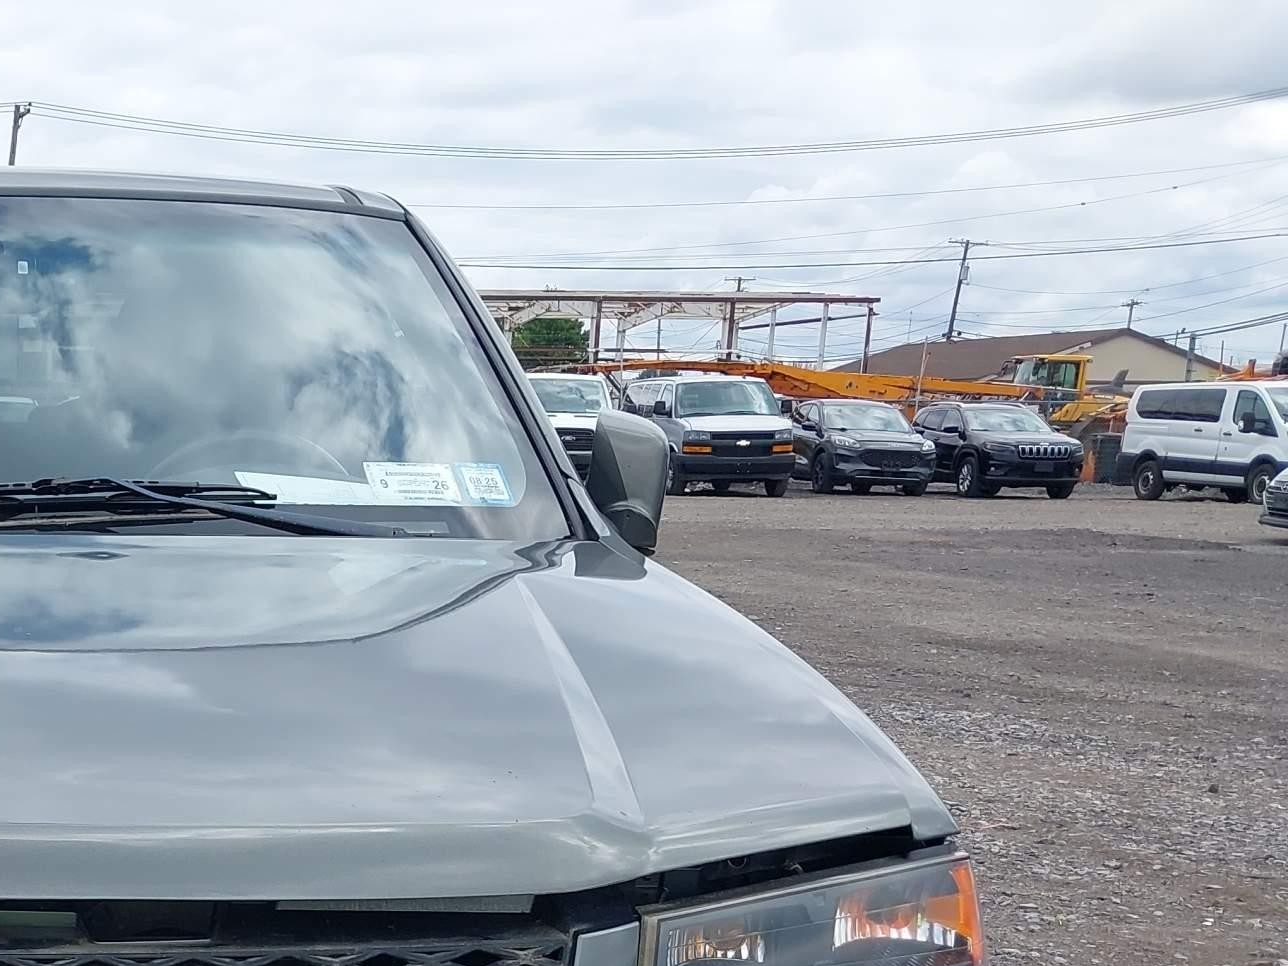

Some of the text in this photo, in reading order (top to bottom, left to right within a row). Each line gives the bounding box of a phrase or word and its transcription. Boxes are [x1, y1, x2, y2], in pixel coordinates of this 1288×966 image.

[380, 479, 388, 489] 9
[432, 480, 449, 490] 26
[485, 477, 498, 485] 25
